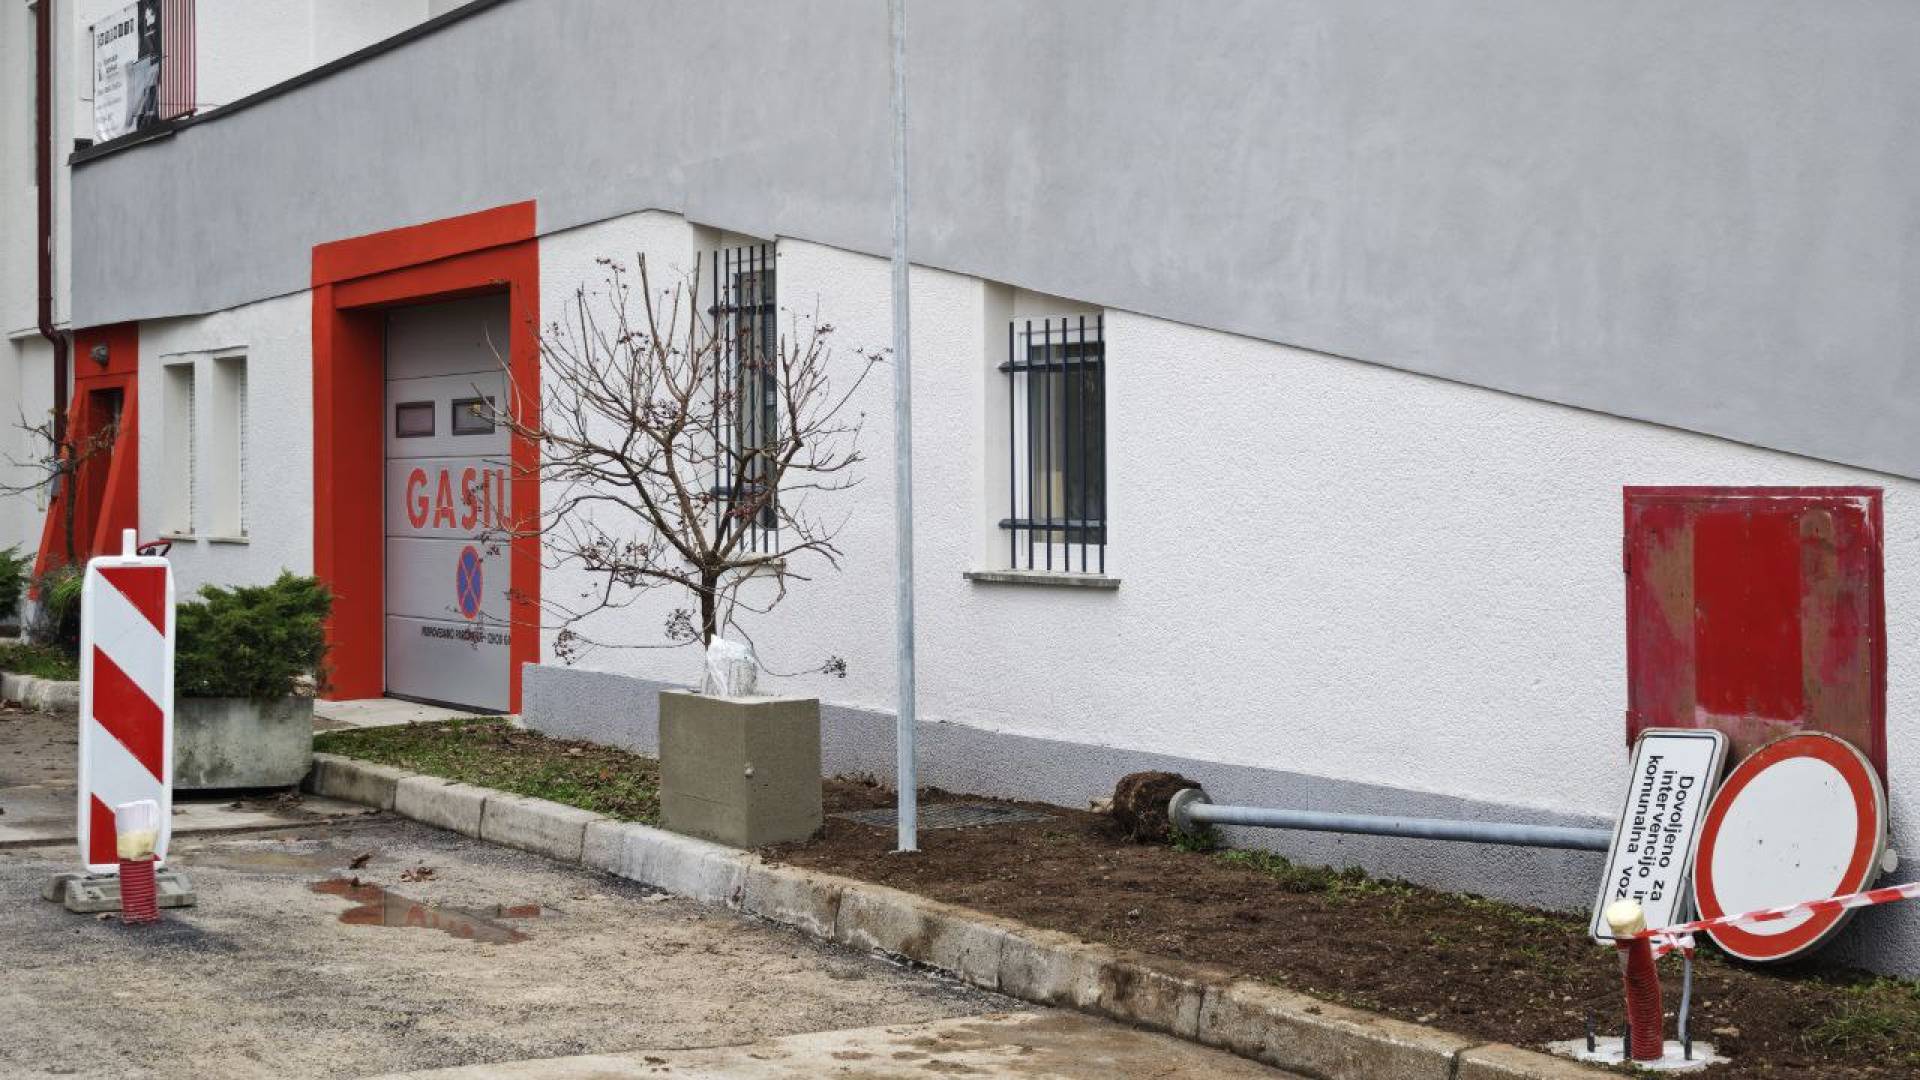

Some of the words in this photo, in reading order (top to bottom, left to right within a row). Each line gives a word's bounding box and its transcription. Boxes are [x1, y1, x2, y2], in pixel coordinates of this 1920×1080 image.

[1627, 755, 1664, 853] komunalna
[1639, 770, 1678, 878] intervencijo
[1659, 776, 1694, 868] Dovoljeno
[1616, 866, 1632, 900] voz
[1650, 880, 1665, 901] za
